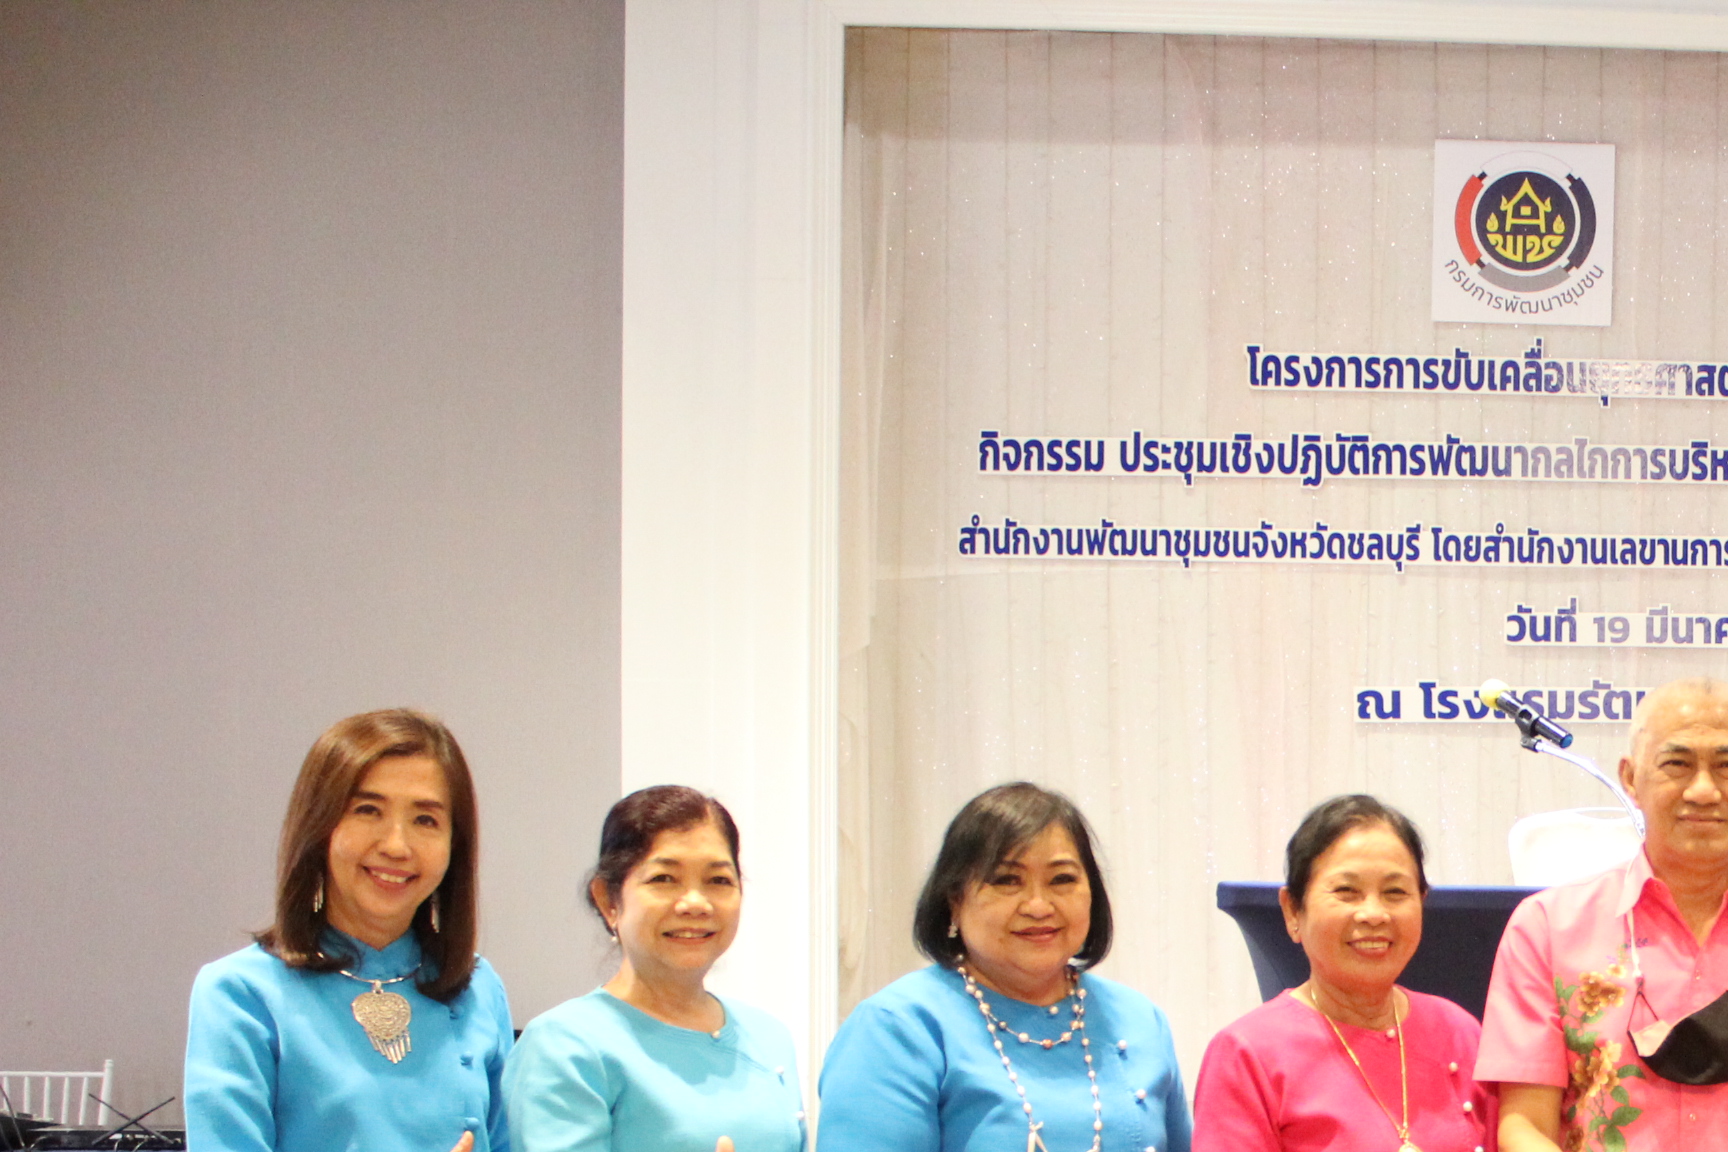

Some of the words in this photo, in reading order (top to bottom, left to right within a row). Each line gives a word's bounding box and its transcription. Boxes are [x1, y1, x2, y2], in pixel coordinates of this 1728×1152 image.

[1445, 259, 1604, 314] กรมการพัฒนาชุมชน
[979, 431, 1104, 471] กิจกรรม
[959, 514, 1421, 571] สำนักงานพัฒนาชุมชนจังหวัดชลบุรี
[1507, 598, 1576, 642] วันที่
[1594, 617, 1629, 642] 19
[1357, 690, 1401, 719] ณ
